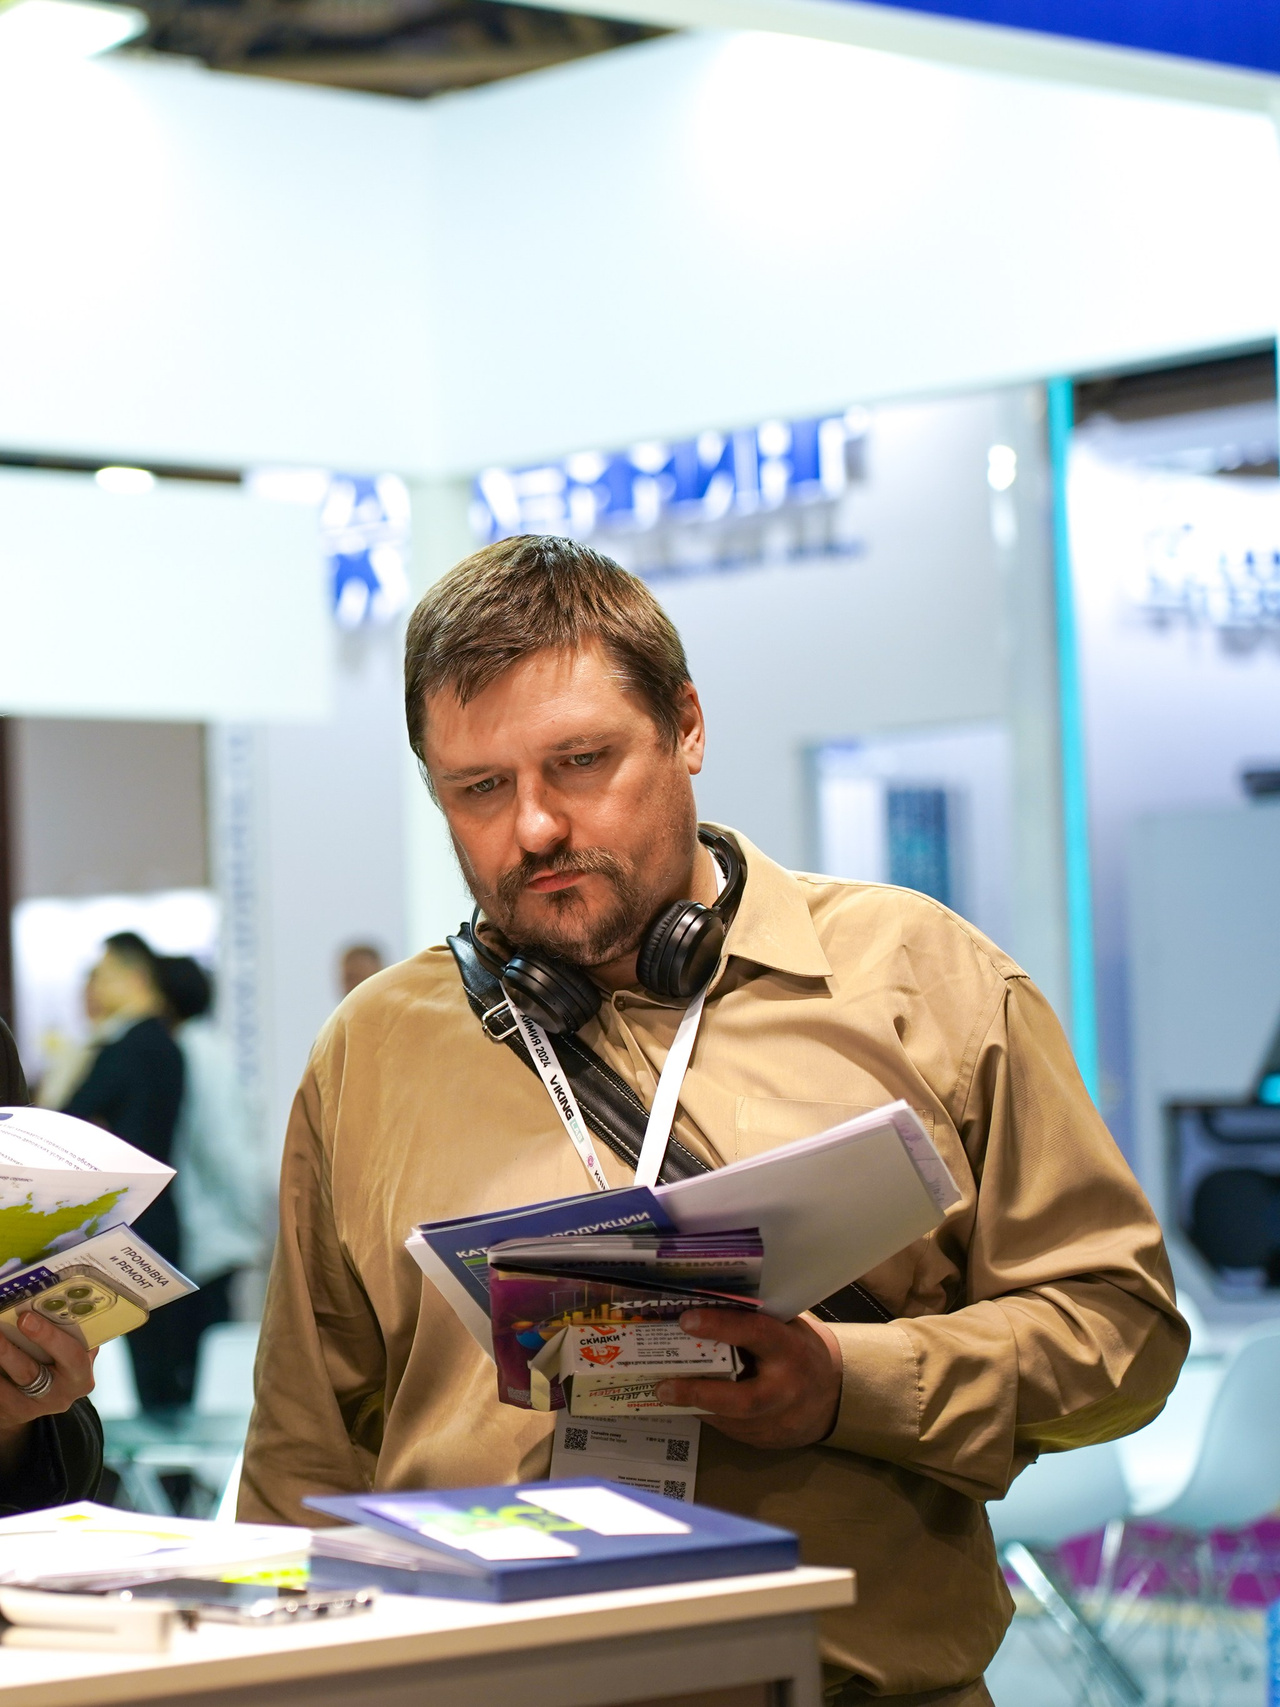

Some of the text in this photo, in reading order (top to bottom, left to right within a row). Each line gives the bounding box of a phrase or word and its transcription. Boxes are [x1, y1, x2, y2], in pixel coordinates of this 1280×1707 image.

[535, 1043, 552, 1068] 2024
[549, 1074, 574, 1121] VIKING
[77, 1157, 102, 1172] обслуж
[593, 1169, 608, 1190] KHI
[546, 1210, 651, 1238] РОДУКЦИИ
[117, 1258, 155, 1290] РЕМОНТ
[120, 1246, 170, 1288] ПРОМЫВКА
[579, 1334, 621, 1346] СКИДКИ
[665, 1350, 680, 1358] 5%
